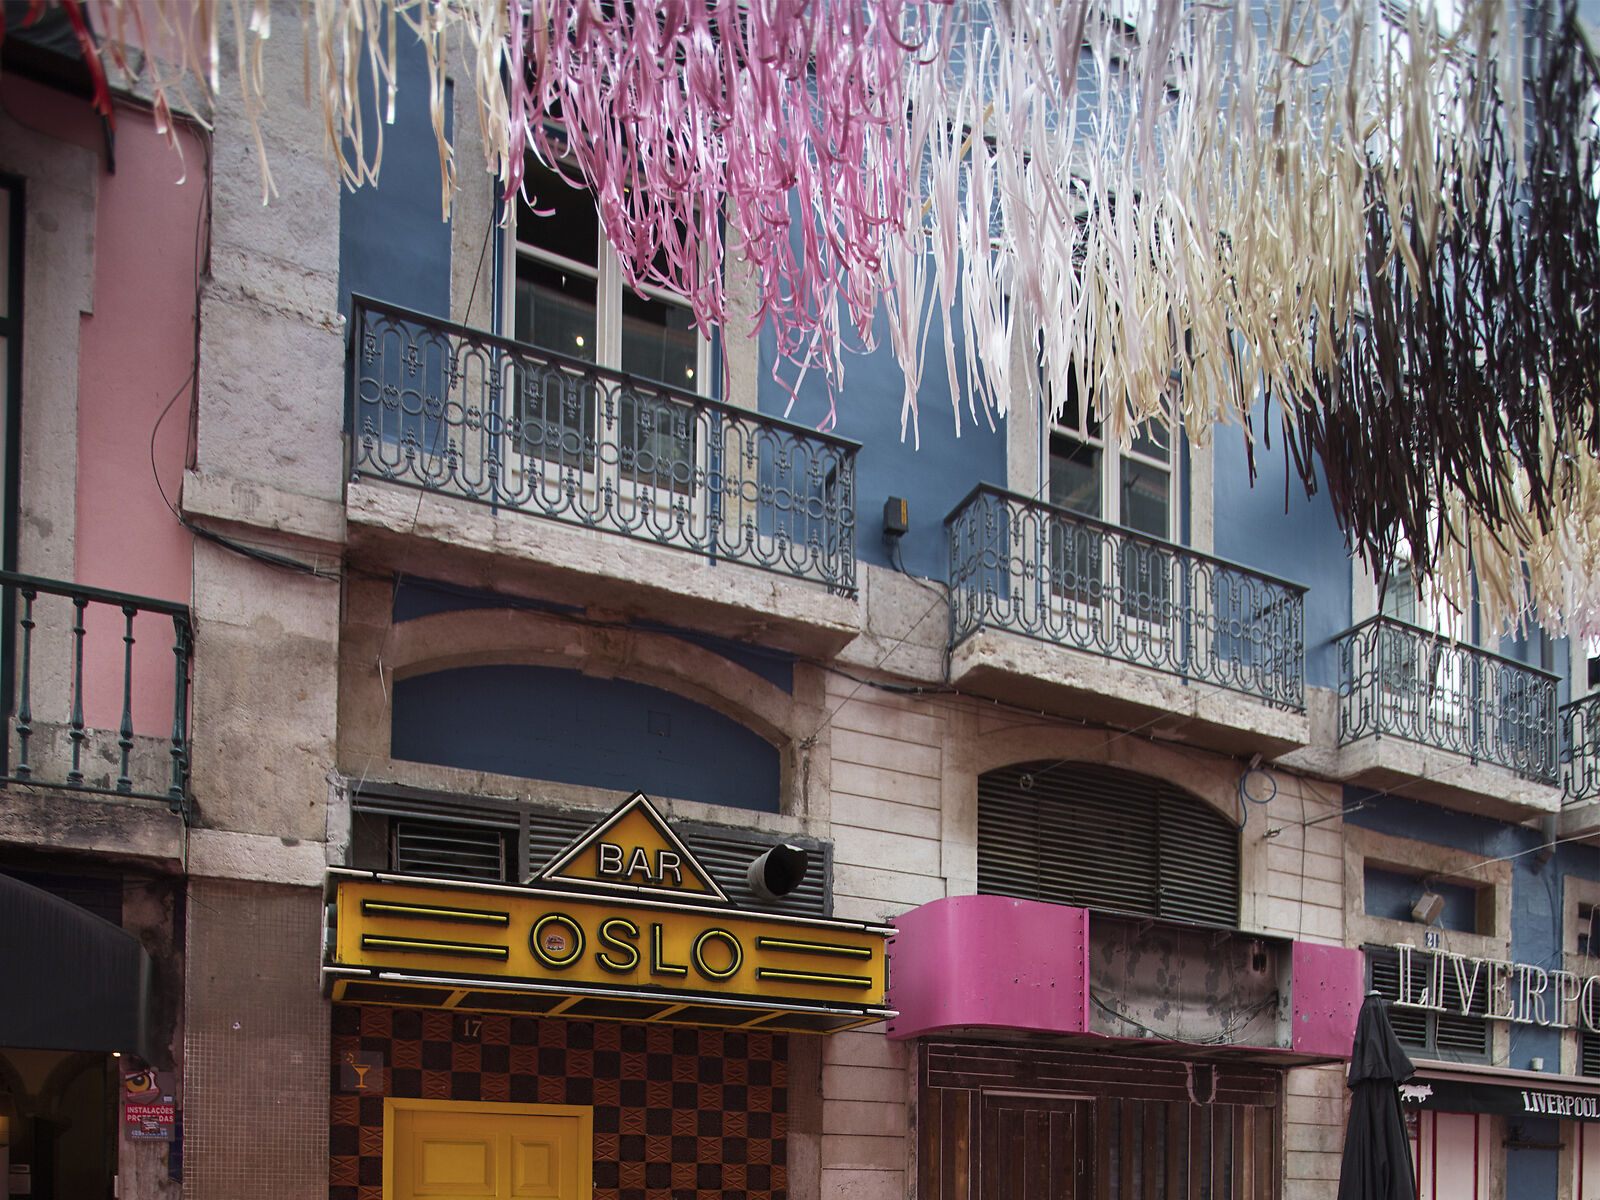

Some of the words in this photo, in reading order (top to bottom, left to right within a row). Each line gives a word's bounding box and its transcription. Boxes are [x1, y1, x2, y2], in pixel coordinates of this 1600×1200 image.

[597, 842, 683, 885] BAR
[528, 912, 744, 983] OSLO
[1427, 933, 1437, 948] 21
[464, 1019, 482, 1037] 17
[1521, 1091, 1600, 1118] LIVERPOOL
